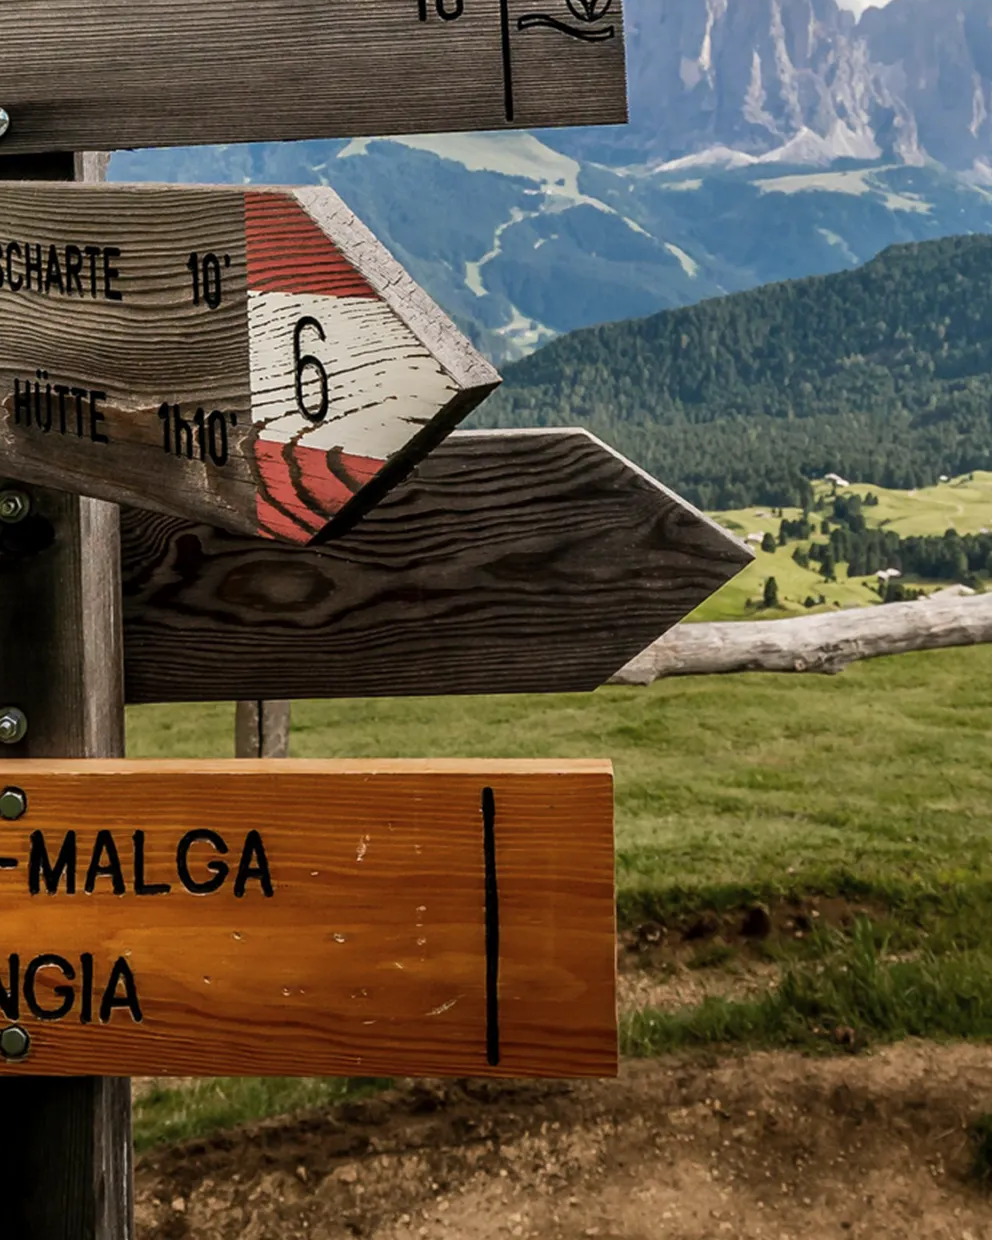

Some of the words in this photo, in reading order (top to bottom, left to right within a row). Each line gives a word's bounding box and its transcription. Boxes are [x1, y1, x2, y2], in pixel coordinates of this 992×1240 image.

[186, 251, 232, 310] 10'
[12, 368, 108, 444] HÜTTE
[293, 315, 329, 423] 6
